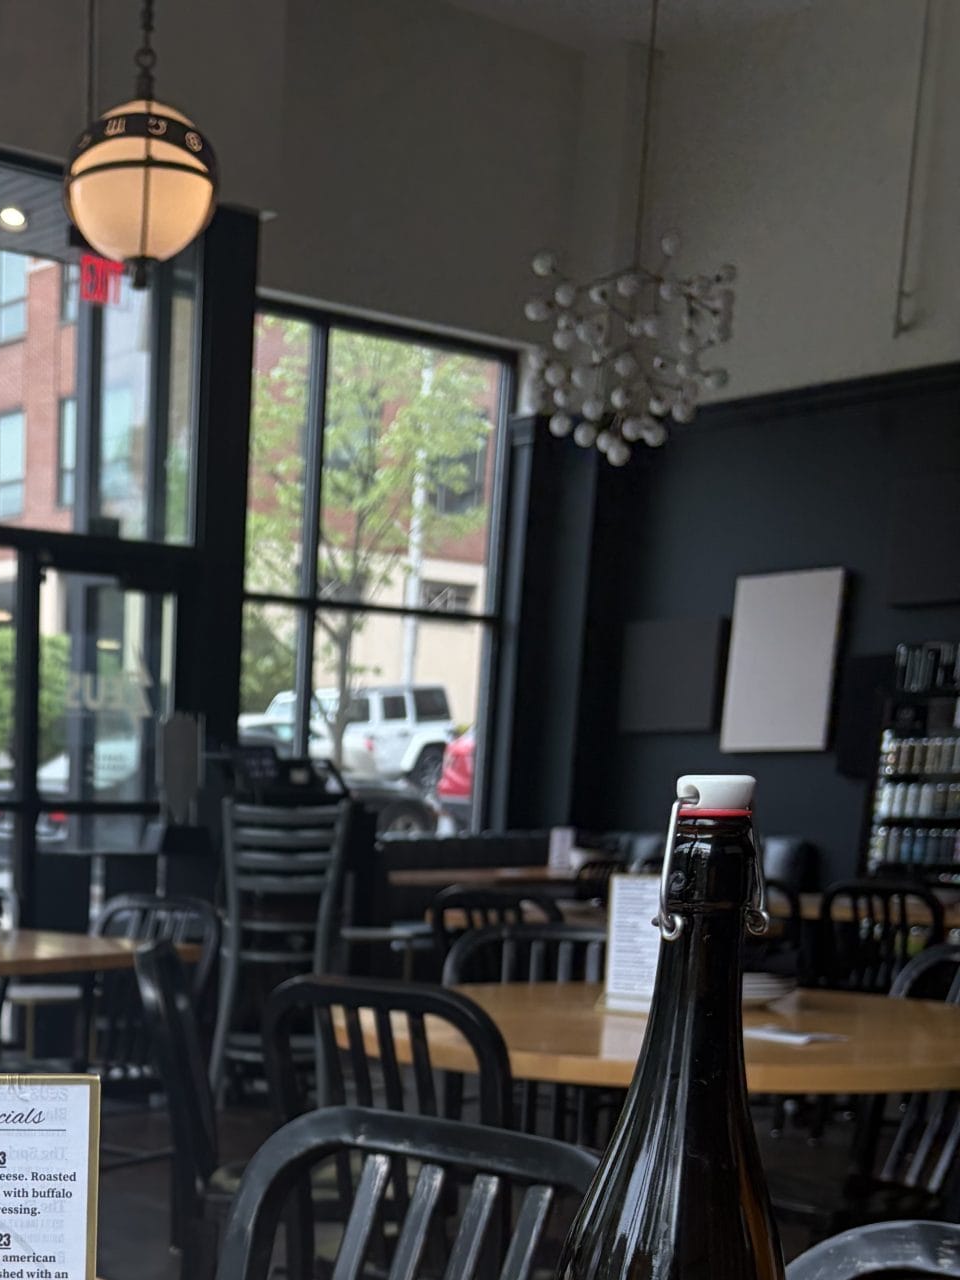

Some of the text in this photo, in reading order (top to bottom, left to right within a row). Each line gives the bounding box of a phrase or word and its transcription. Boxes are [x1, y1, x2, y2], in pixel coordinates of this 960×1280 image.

[80, 254, 125, 304] EXIT
[30, 1171, 77, 1183] Roasted
[2, 1187, 30, 1199] with
[31, 1187, 74, 1199] buffalo
[1, 1251, 57, 1264] american
[25, 1267, 53, 1280] with
[53, 1271, 70, 1280] an
